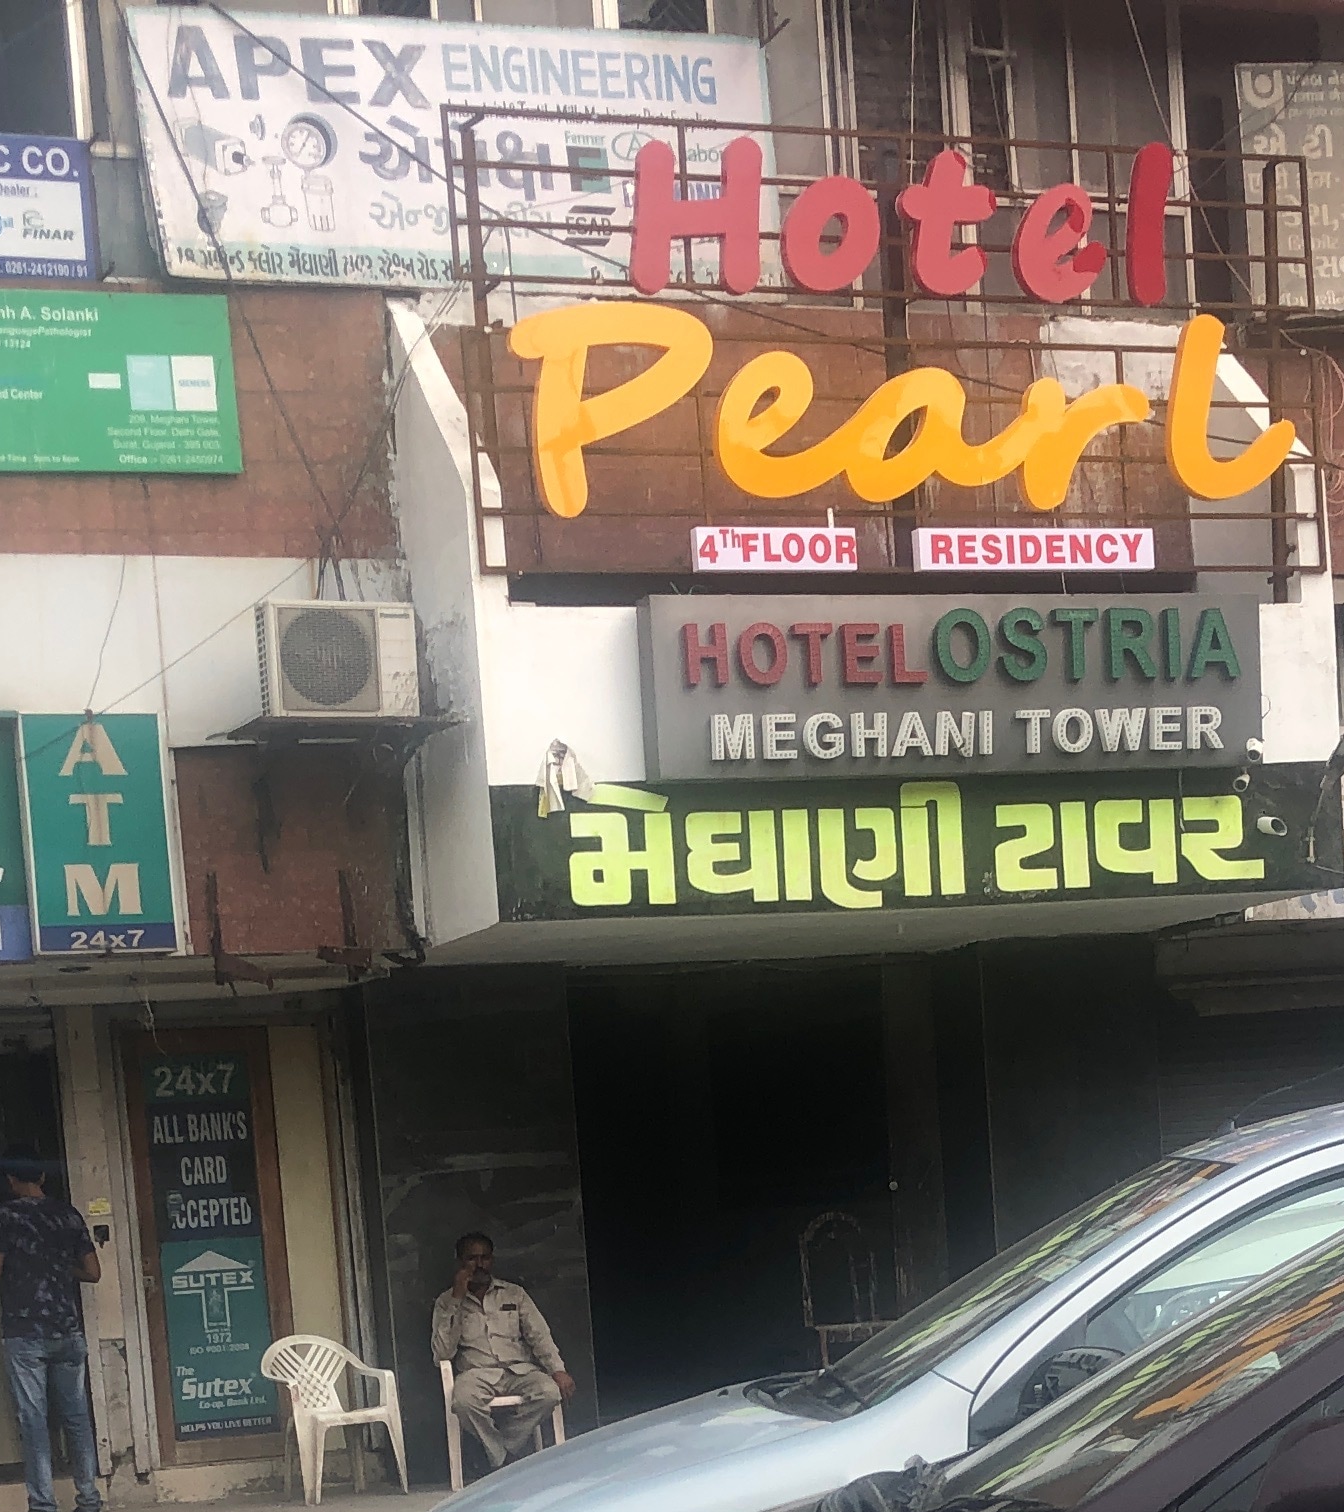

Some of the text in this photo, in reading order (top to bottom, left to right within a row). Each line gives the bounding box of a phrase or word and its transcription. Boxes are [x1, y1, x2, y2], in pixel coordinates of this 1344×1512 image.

[167, 25, 718, 109] APEX ENGINEERING
[22, 145, 80, 178] CO.
[22, 228, 74, 242] FINAR
[630, 136, 1175, 308] Hotel
[20, 305, 36, 321] A.
[40, 306, 99, 322] Solanki
[10, 388, 43, 401] Center
[508, 301, 1297, 520] Pearl
[930, 533, 1144, 565] RESIDENCY
[680, 606, 1242, 687] HOTEL OSTRIA
[709, 705, 1224, 761] MEGHANI TOWER
[568, 781, 1266, 910] મેઘાણી ટાવર
[153, 1062, 235, 1098] 24x7
[153, 1110, 248, 1145] ALL BANK'S
[180, 1155, 228, 1186] CARD
[167, 1196, 252, 1230] CCEPTED
[172, 1269, 255, 1289] SUTEX
[206, 1332, 233, 1344] 1972
[175, 1366, 195, 1377] The
[181, 1377, 254, 1401] Sutex
